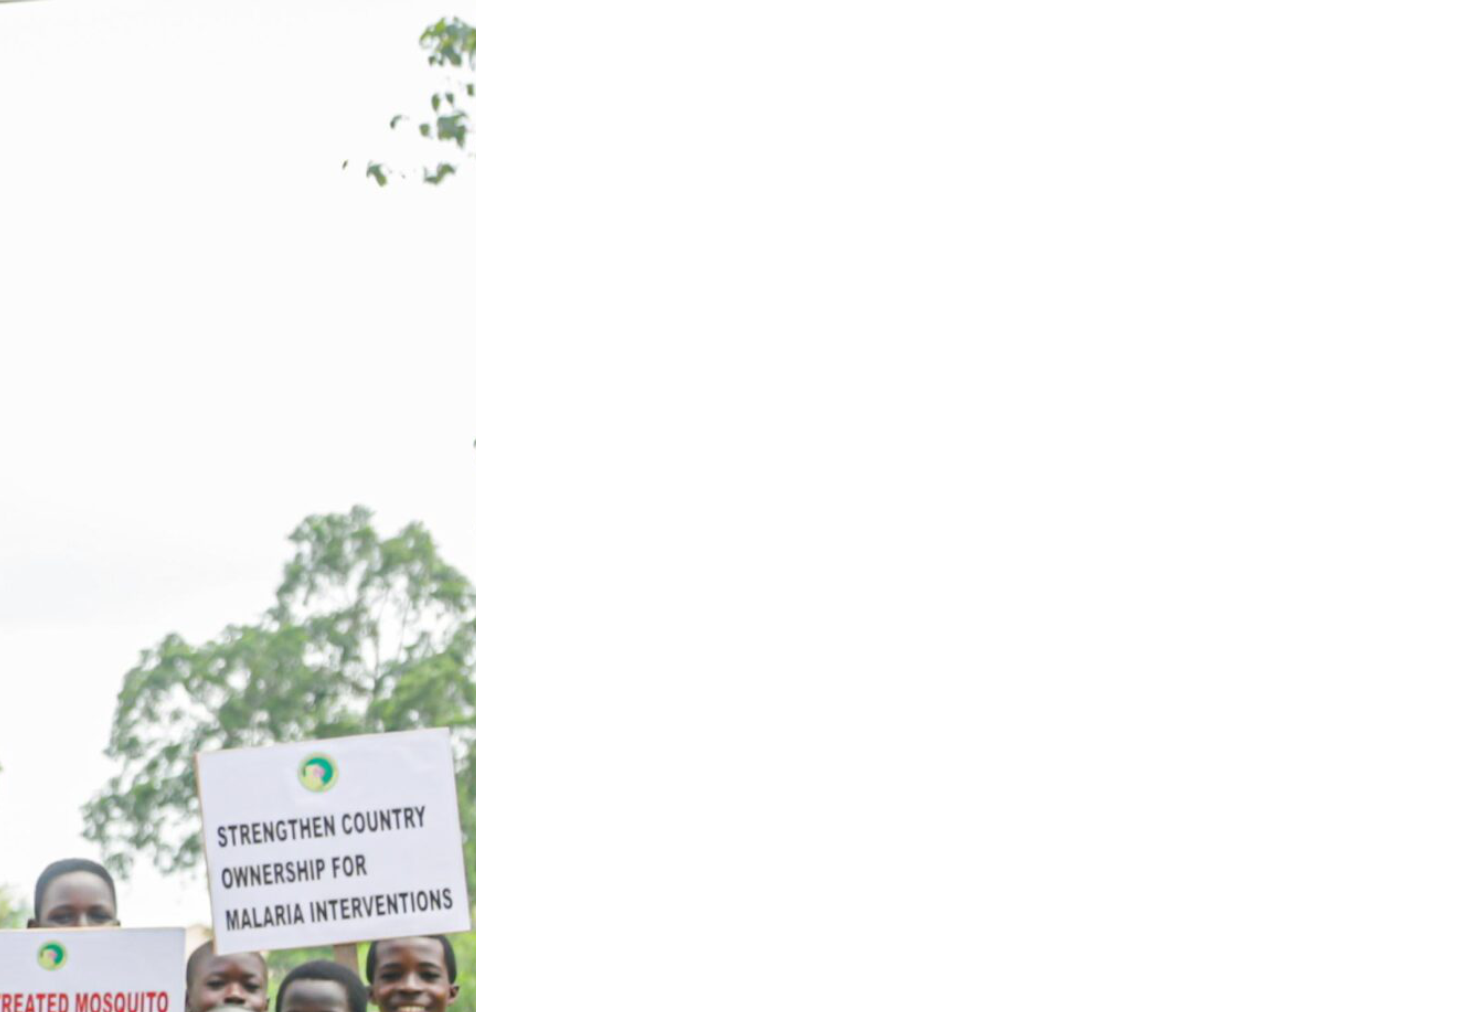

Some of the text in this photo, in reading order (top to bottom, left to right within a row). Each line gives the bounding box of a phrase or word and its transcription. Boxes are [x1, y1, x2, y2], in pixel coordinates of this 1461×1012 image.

[216, 805, 426, 848] STRENGTHEN COUNTRY
[220, 853, 368, 890] OWNERSHIP FOR
[224, 887, 454, 932] MALARIA INTERVENTIONS
